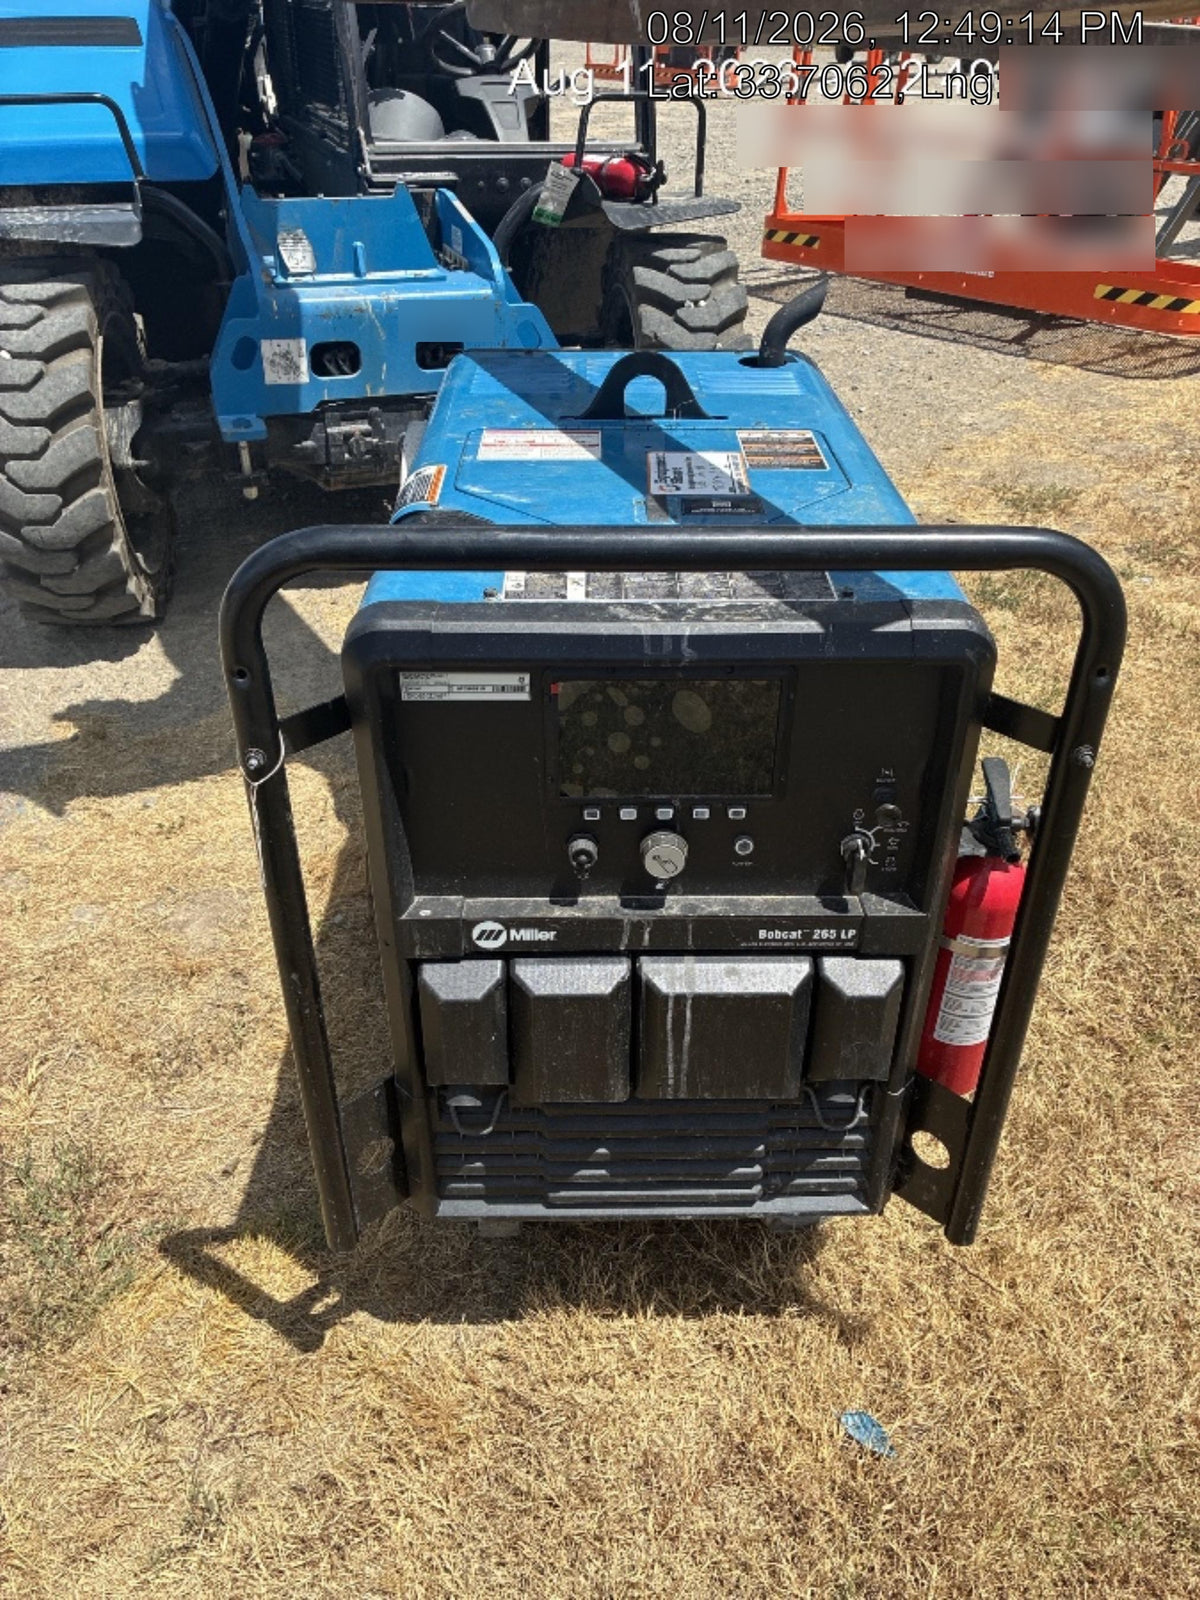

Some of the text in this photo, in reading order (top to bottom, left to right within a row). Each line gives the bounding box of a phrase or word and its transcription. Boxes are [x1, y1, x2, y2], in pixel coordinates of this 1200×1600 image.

[509, 927, 557, 941] Miller
[812, 928, 837, 940] 265
[840, 928, 857, 940] LP
